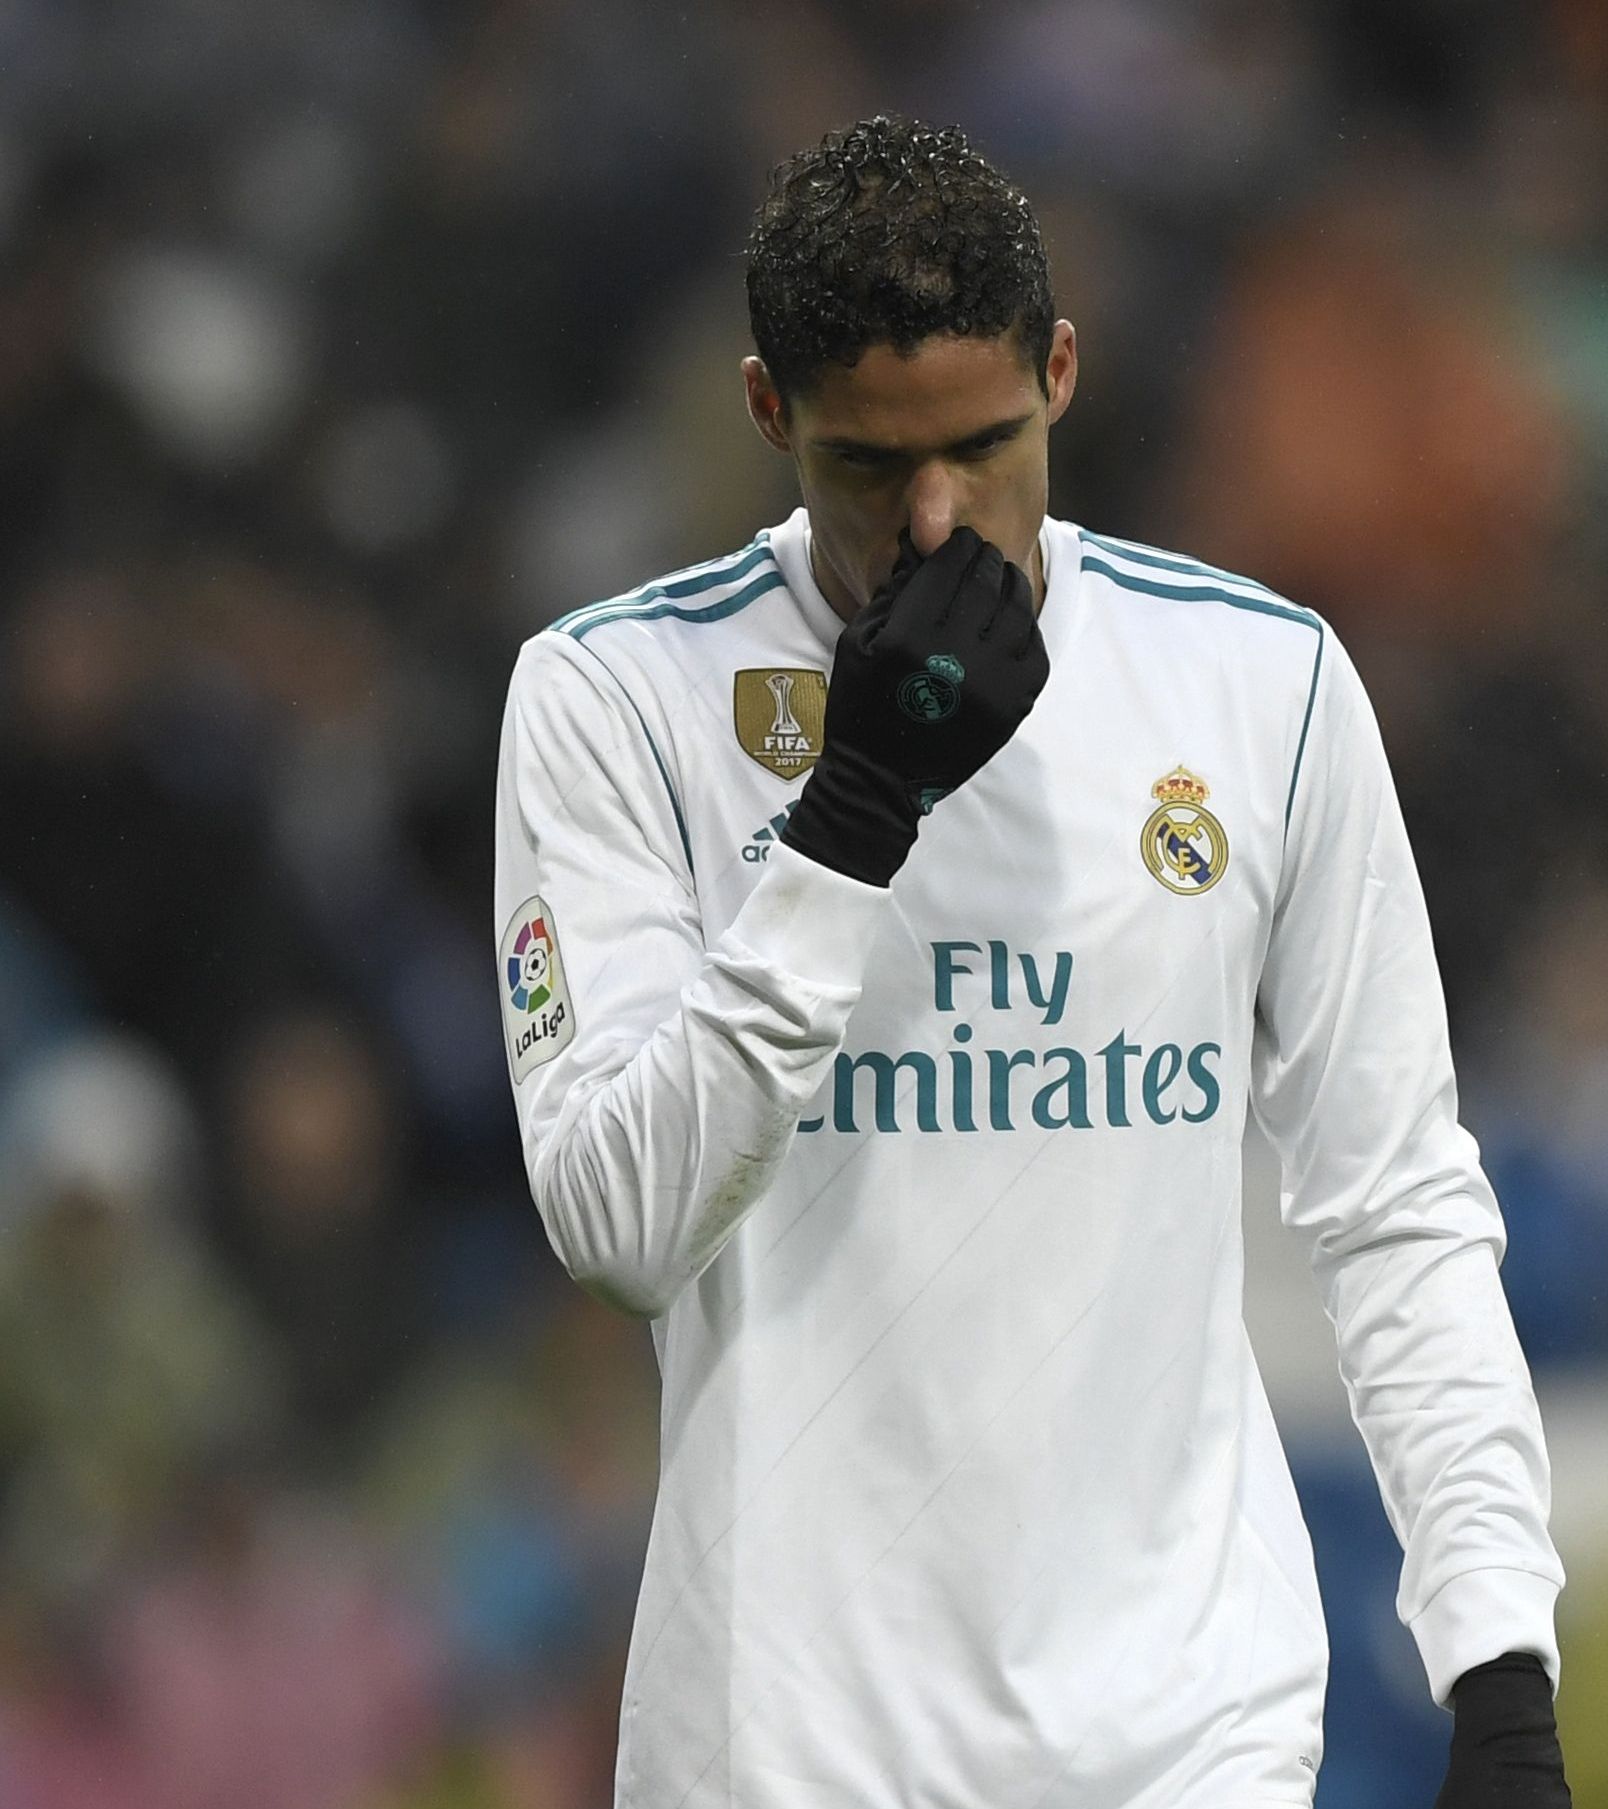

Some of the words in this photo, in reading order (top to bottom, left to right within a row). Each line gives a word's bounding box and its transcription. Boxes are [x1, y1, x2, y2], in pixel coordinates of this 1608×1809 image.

[764, 736, 810, 750] FIFA
[774, 757, 802, 767] 2017
[929, 939, 1074, 1026] Fly
[515, 1001, 566, 1060] LaLiga
[797, 1022, 1222, 1133] mirates
